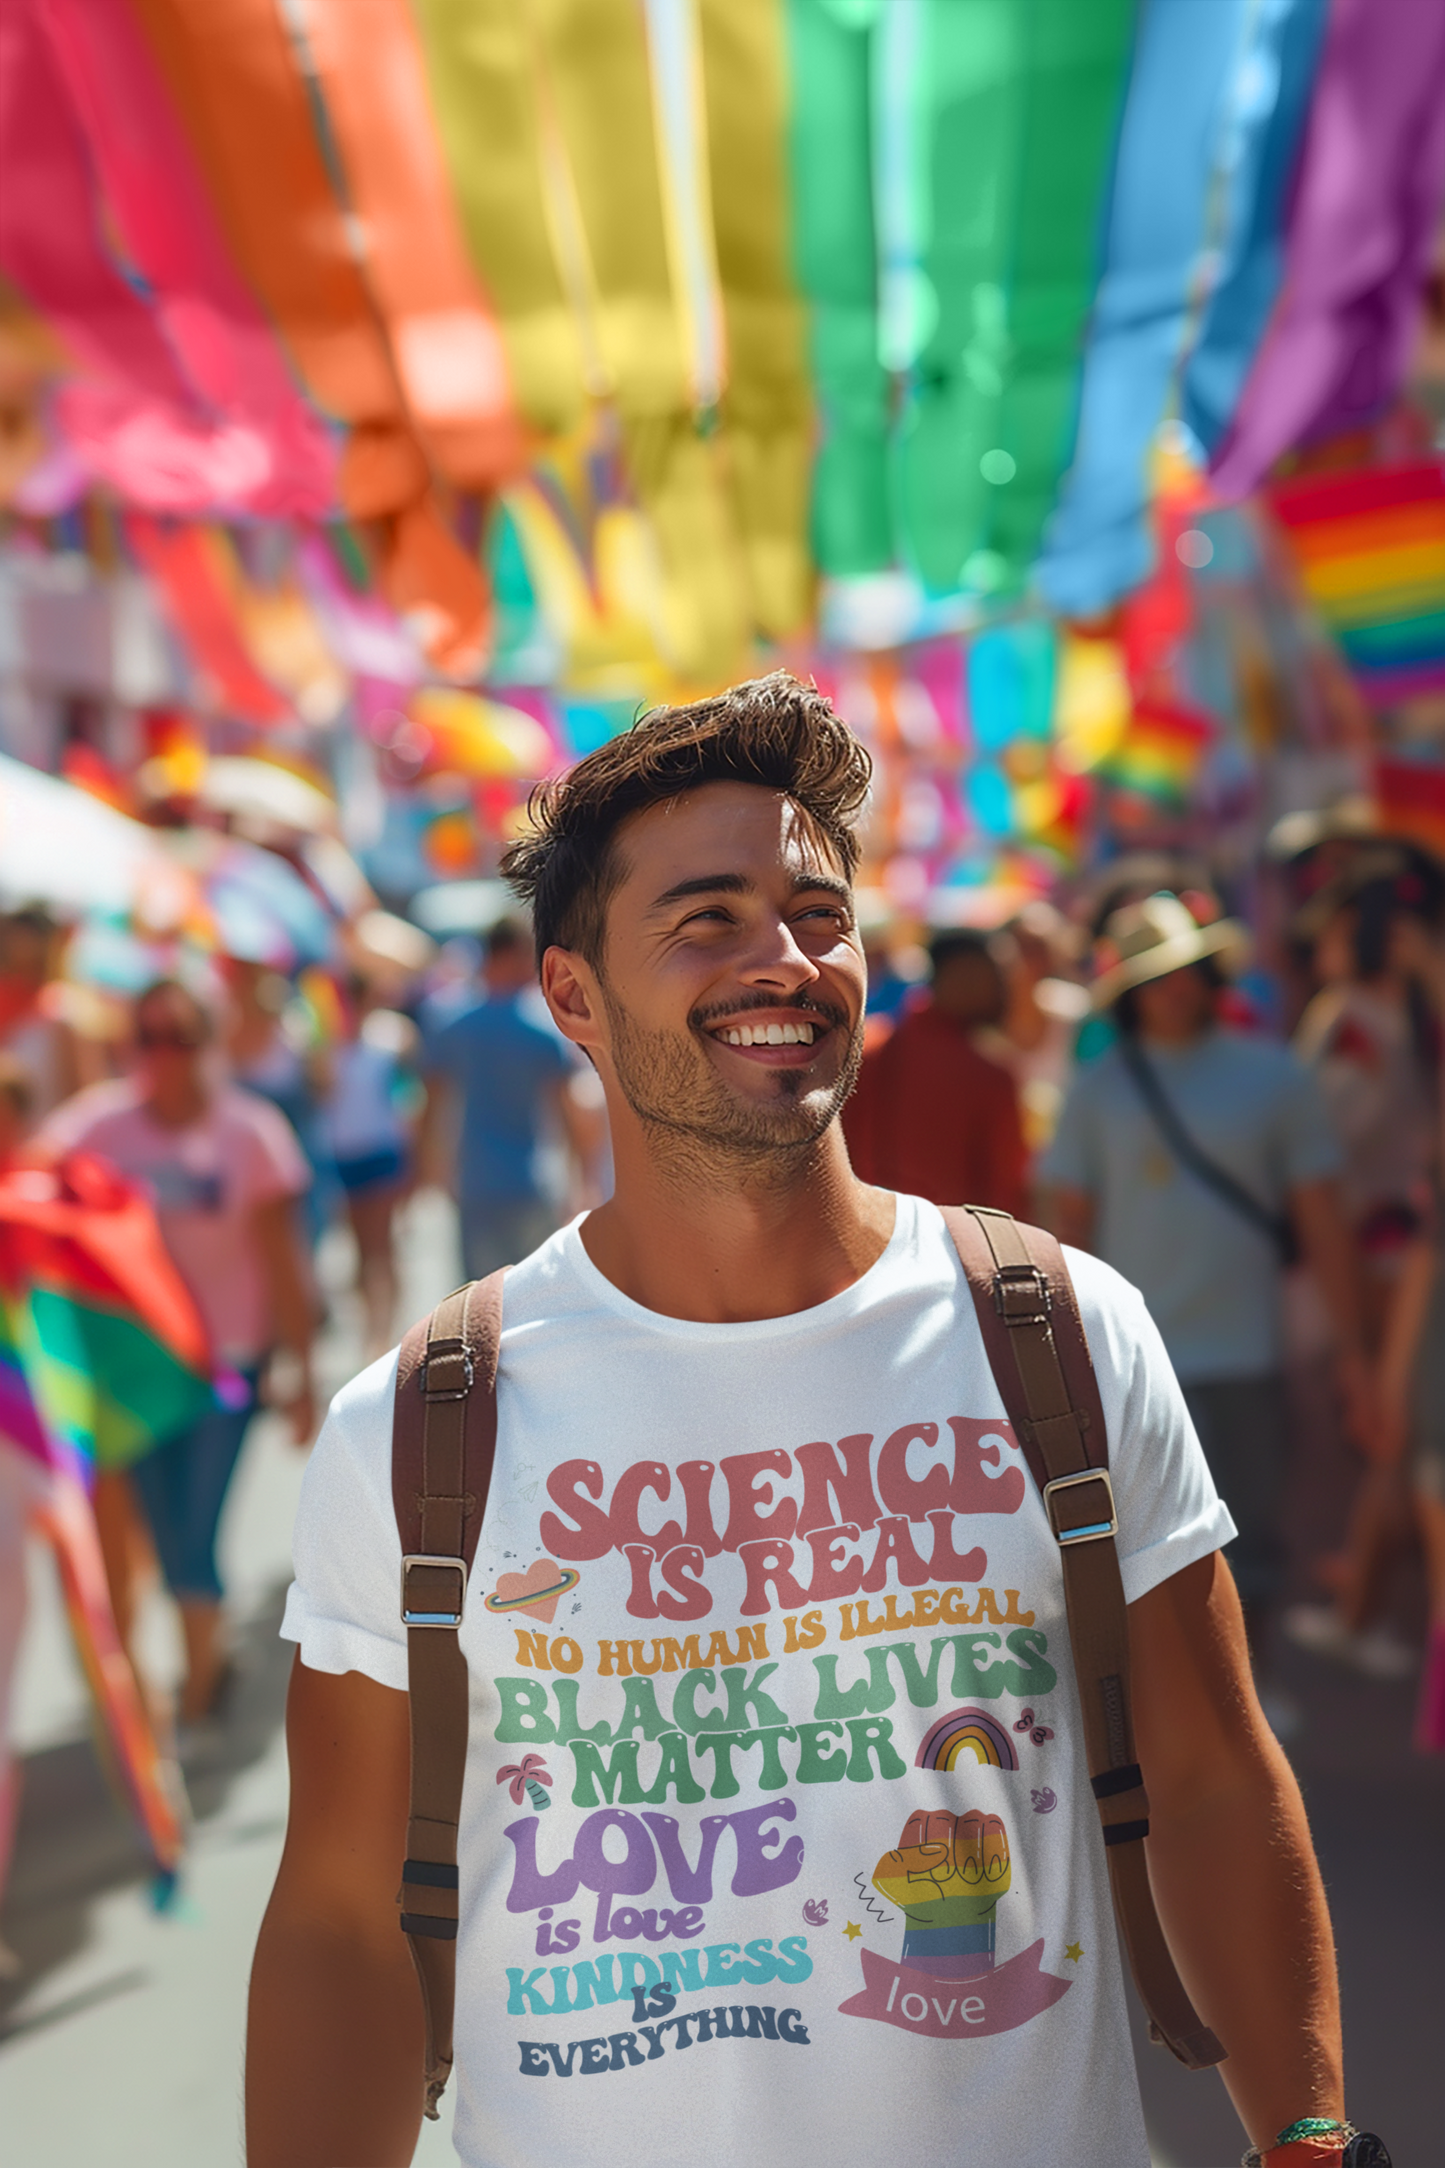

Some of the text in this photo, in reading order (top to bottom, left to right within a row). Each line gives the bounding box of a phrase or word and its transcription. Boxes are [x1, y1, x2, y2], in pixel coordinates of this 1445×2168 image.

[540, 1416, 1026, 1561] SCIENCE
[622, 1510, 988, 1621] IS REAL
[514, 1587, 1035, 1676] NO HUMAN IS ILLEGAL
[493, 1662, 789, 1747] BLACK
[812, 1628, 1058, 1721] LIVES
[568, 1717, 907, 1807] MATTER
[503, 1797, 805, 1914] LOVE
[535, 1893, 706, 1957] is love
[505, 1936, 814, 2016] KINDNESS
[631, 1982, 677, 2023] IS
[886, 1976, 986, 2026] love
[518, 2005, 811, 2078] EVERYTHING
